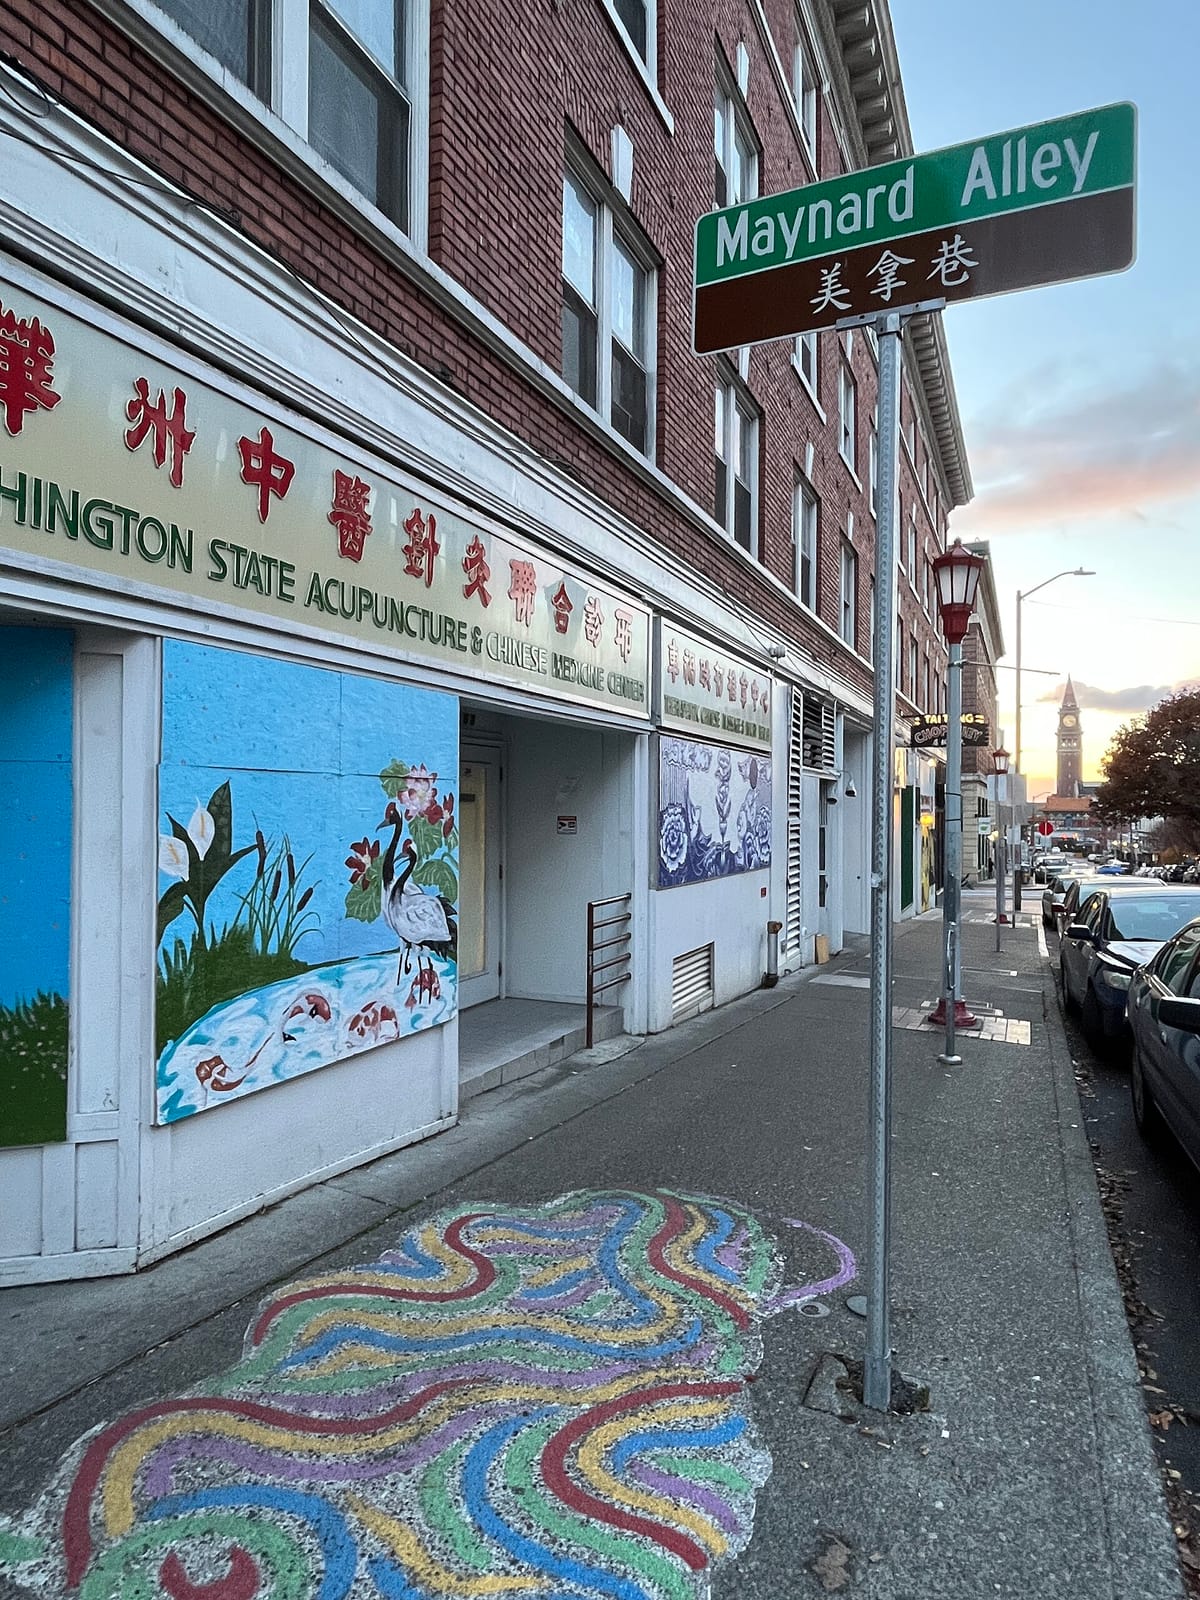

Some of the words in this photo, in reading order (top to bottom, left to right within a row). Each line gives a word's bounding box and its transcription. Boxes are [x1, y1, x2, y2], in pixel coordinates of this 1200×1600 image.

[716, 164, 914, 267] Maynard
[961, 130, 1099, 206] Alley
[809, 233, 980, 315] 美拿巷
[0, 464, 194, 574] HINGTON
[208, 538, 296, 602] STATE
[304, 572, 468, 652] ACUPUNCTURE
[470, 625, 483, 657] &
[486, 632, 548, 676] CHINESE
[551, 652, 605, 692] MEDICINE
[607, 672, 645, 703] CENTER
[914, 725, 948, 743] CHOP
[924, 714, 942, 724] TAI
[942, 713, 974, 724] TNG
